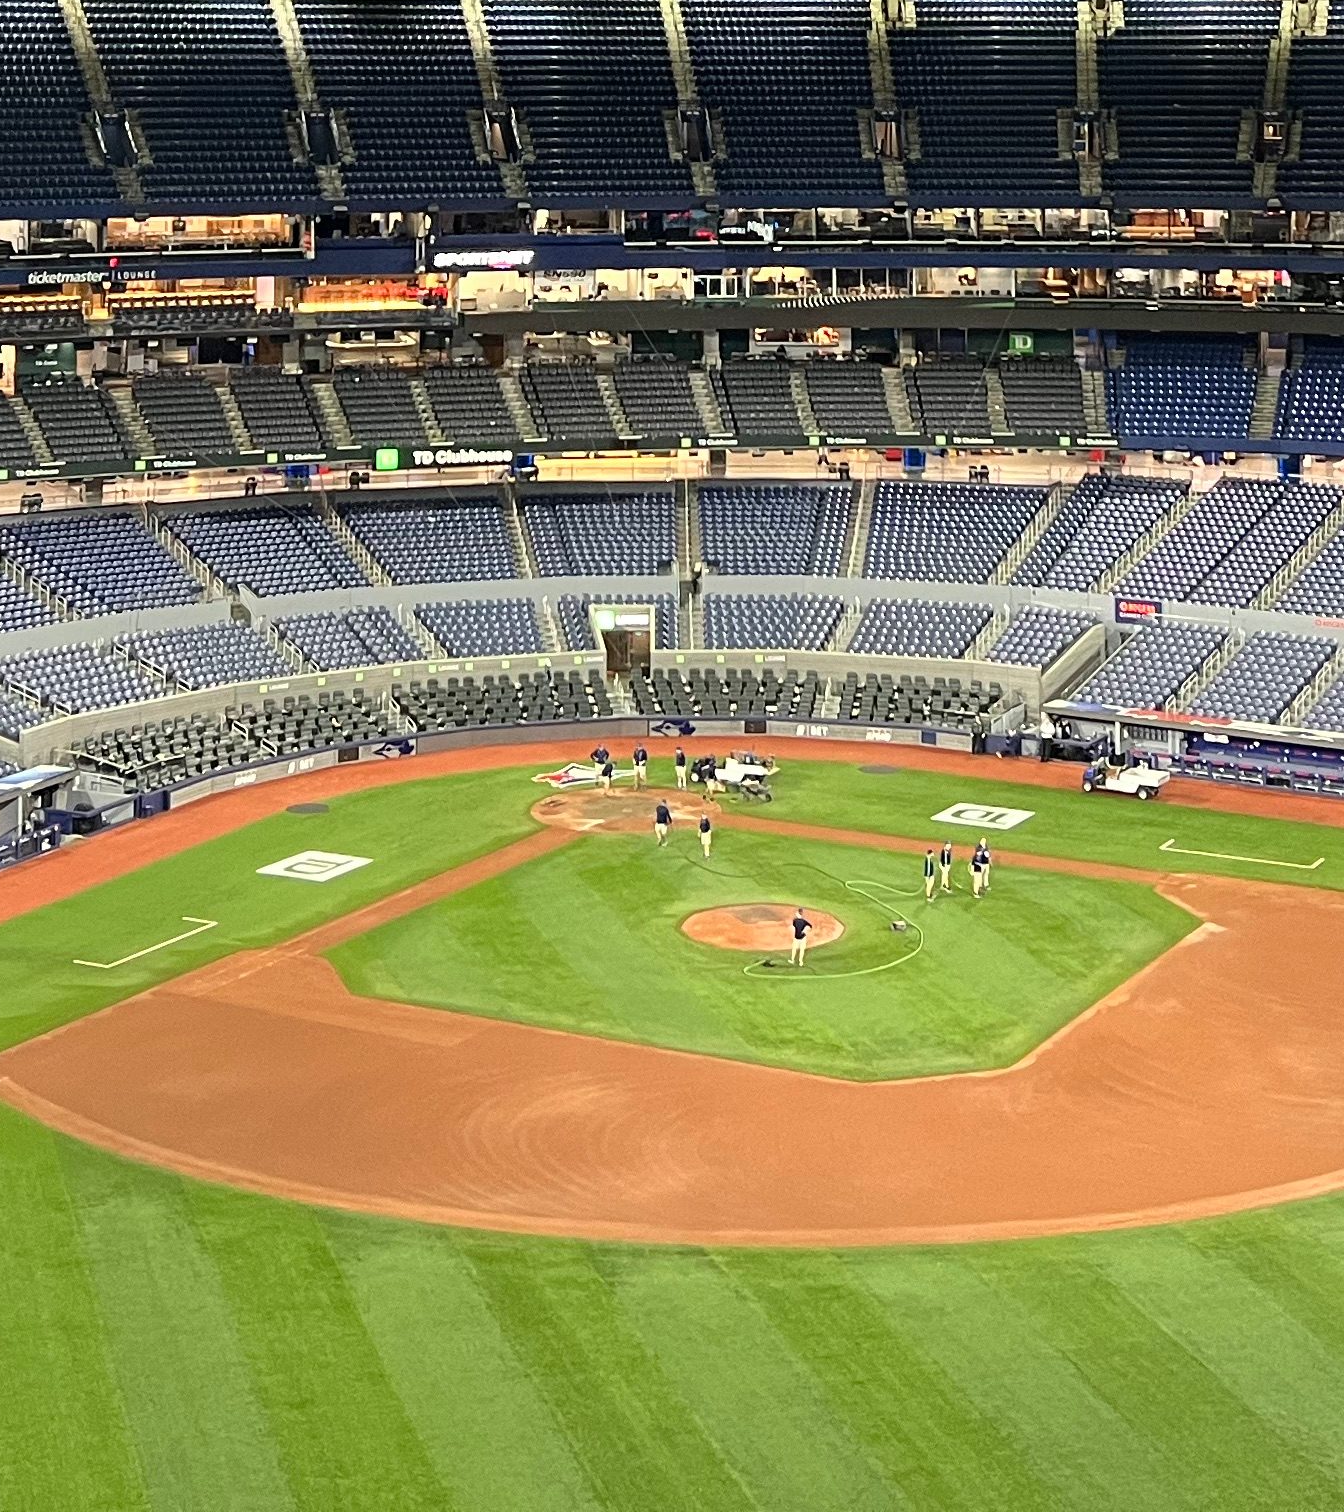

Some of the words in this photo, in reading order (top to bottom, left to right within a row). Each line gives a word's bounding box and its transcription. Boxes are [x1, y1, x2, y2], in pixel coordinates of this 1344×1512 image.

[28, 270, 106, 284] ticketmaster
[117, 270, 156, 280] LOUNGE
[413, 450, 434, 465] TD
[435, 449, 513, 464] Clubhouse
